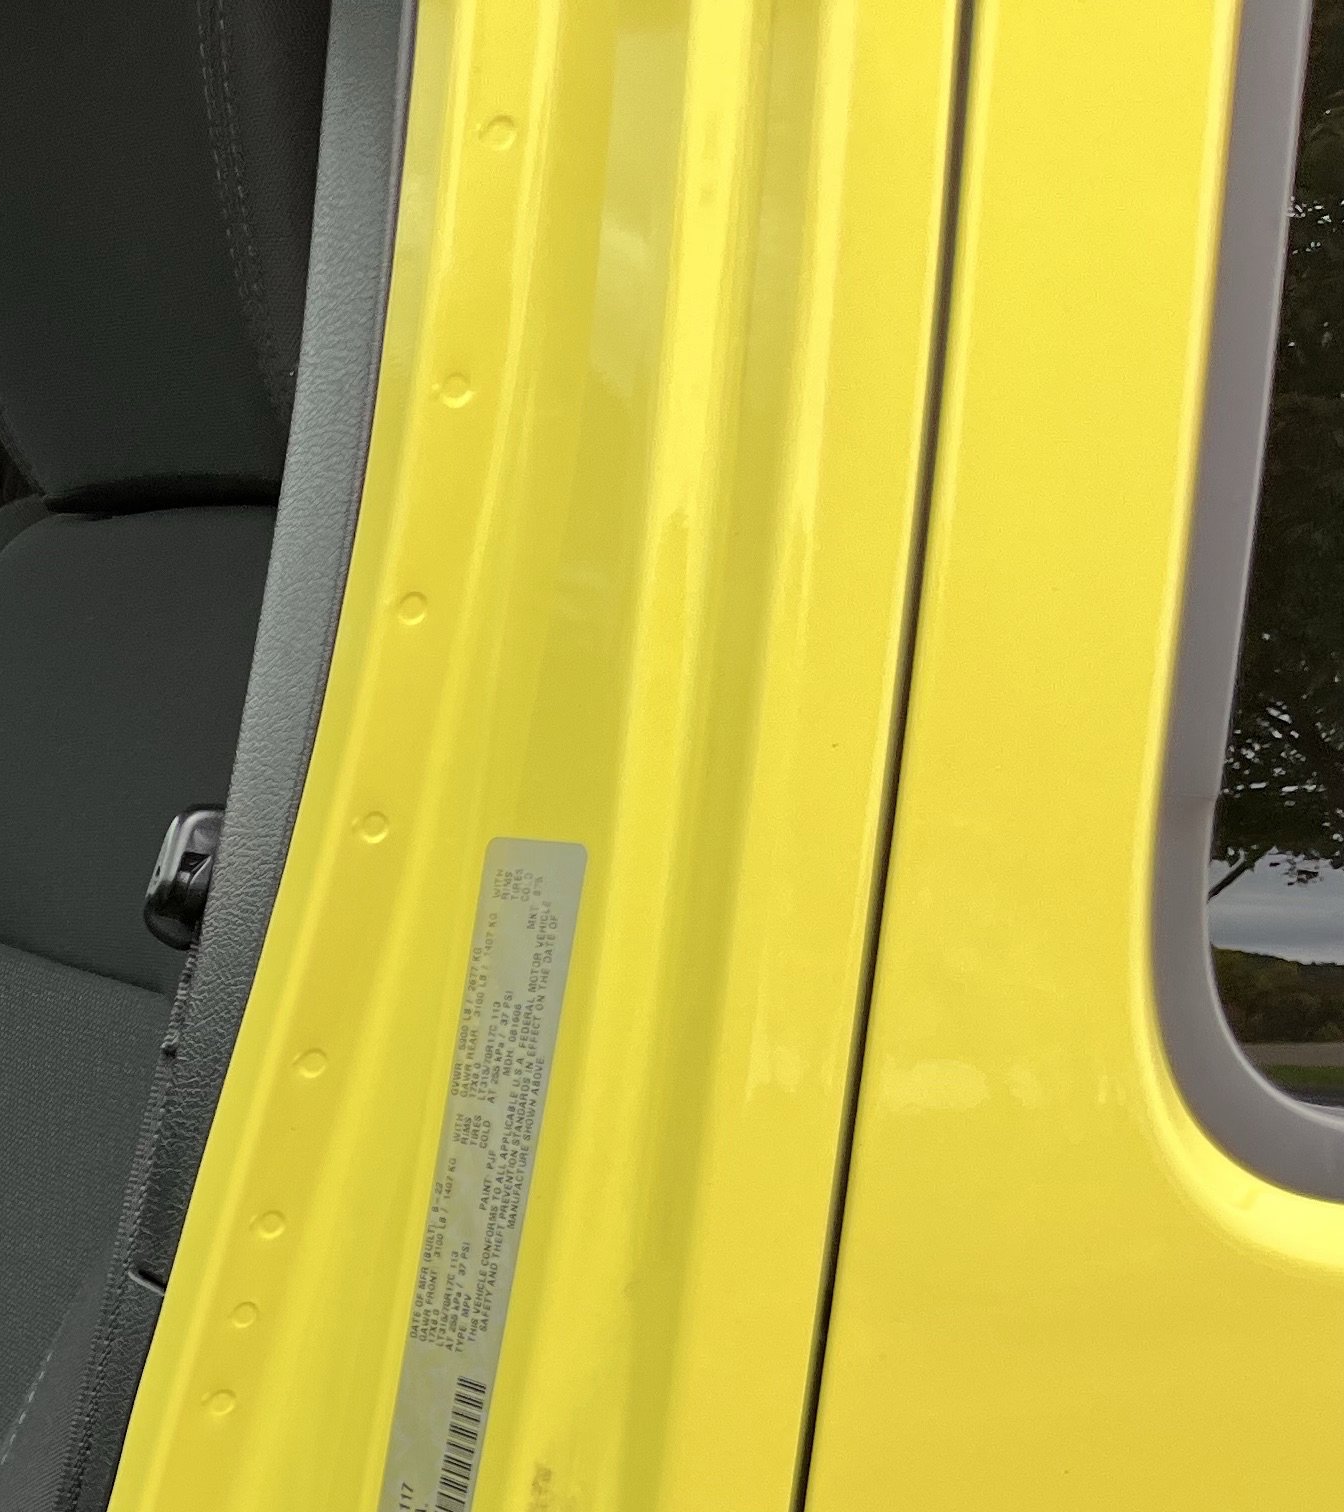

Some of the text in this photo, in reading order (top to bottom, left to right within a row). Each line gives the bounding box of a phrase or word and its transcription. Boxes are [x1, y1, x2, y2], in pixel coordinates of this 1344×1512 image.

[535, 900, 552, 948] VEHICLE
[527, 952, 542, 992] MOTOR
[517, 995, 535, 1049] FEDERAL
[478, 914, 560, 1332] SAFETY AND THEFT PREVENTION STANDARDS IN EFFECT ON THE DATE OF
[498, 1091, 518, 1160] APPLICABLE
[494, 1162, 506, 1184] ALL
[506, 1144, 529, 1230] MANUFACTURE
[521, 1097, 537, 1141] SHOWN
[491, 1186, 501, 1201] TO
[480, 1204, 498, 1267] CONFORMS
[471, 1270, 487, 1315] VEHICLE
[467, 1317, 479, 1342] THIS
